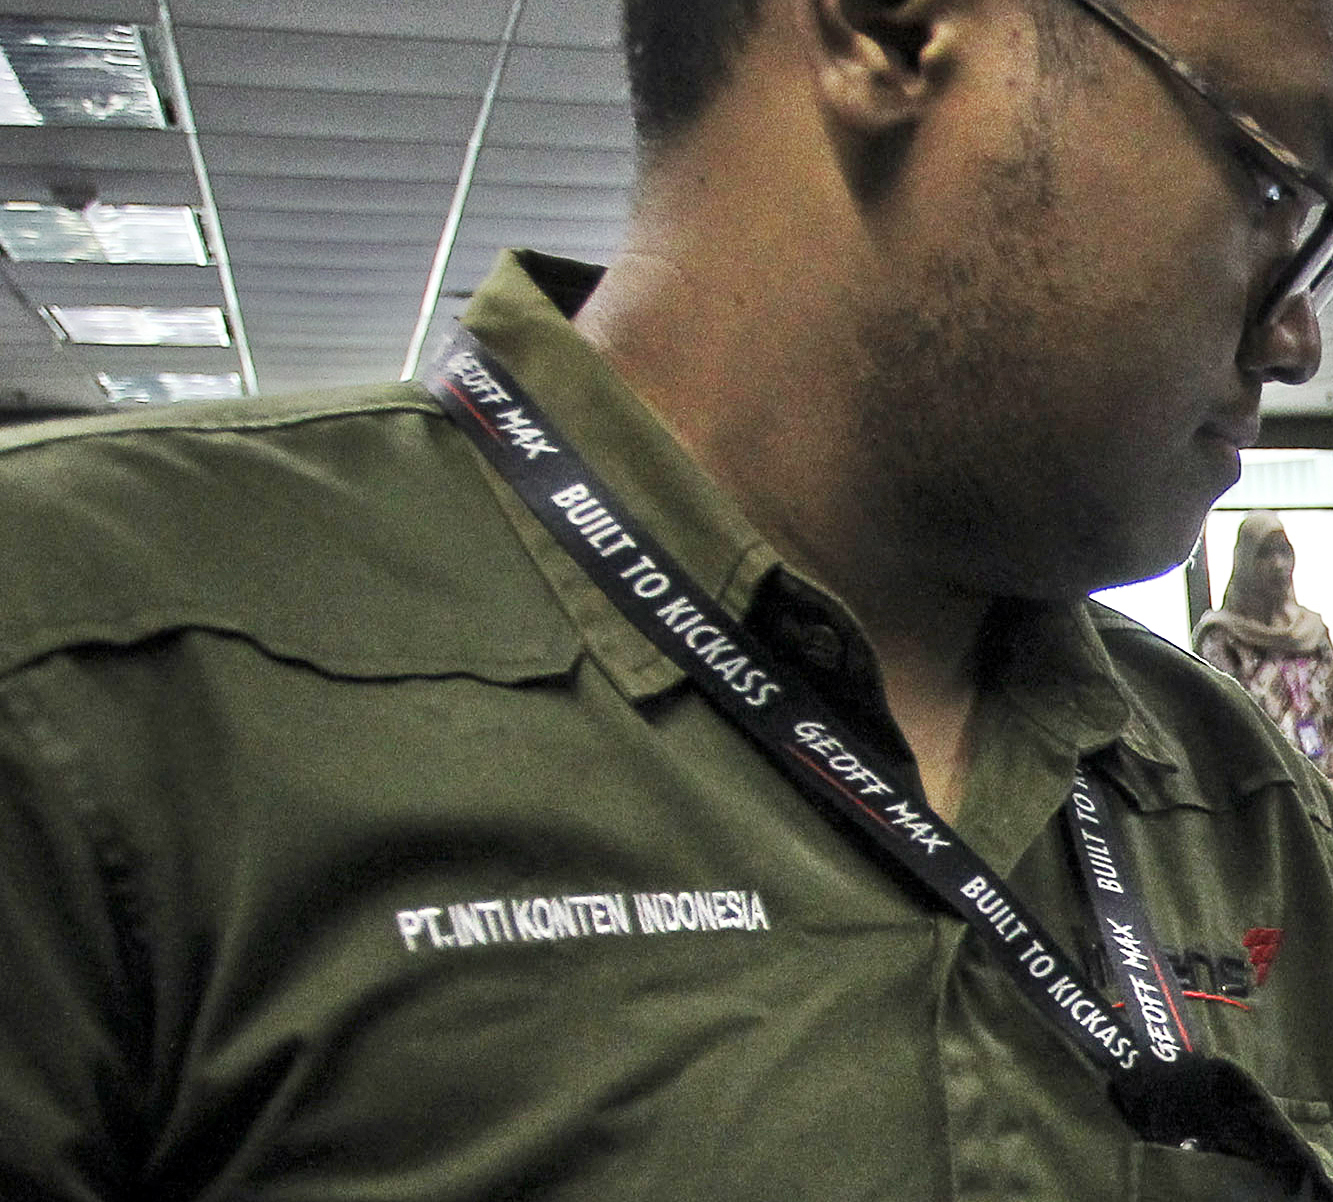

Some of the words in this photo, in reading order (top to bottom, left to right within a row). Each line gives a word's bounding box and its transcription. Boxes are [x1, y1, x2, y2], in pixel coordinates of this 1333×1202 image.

[496, 407, 560, 460] MAX
[550, 483, 637, 557] BUILT
[619, 555, 670, 598] TO
[656, 596, 781, 706] KICKASS
[793, 721, 895, 795] GEOFF
[885, 801, 951, 854] MAX
[1072, 793, 1099, 824] TO
[1081, 828, 1124, 893] BUILT
[512, 893, 631, 942] KONTEN
[634, 890, 770, 935] INDONESIA
[1106, 917, 1149, 971] MAX
[960, 875, 1028, 942] BUILT
[1020, 939, 1055, 978] TO
[1047, 975, 1139, 1069] KICKASS
[1129, 974, 1180, 1062] GEOFF
